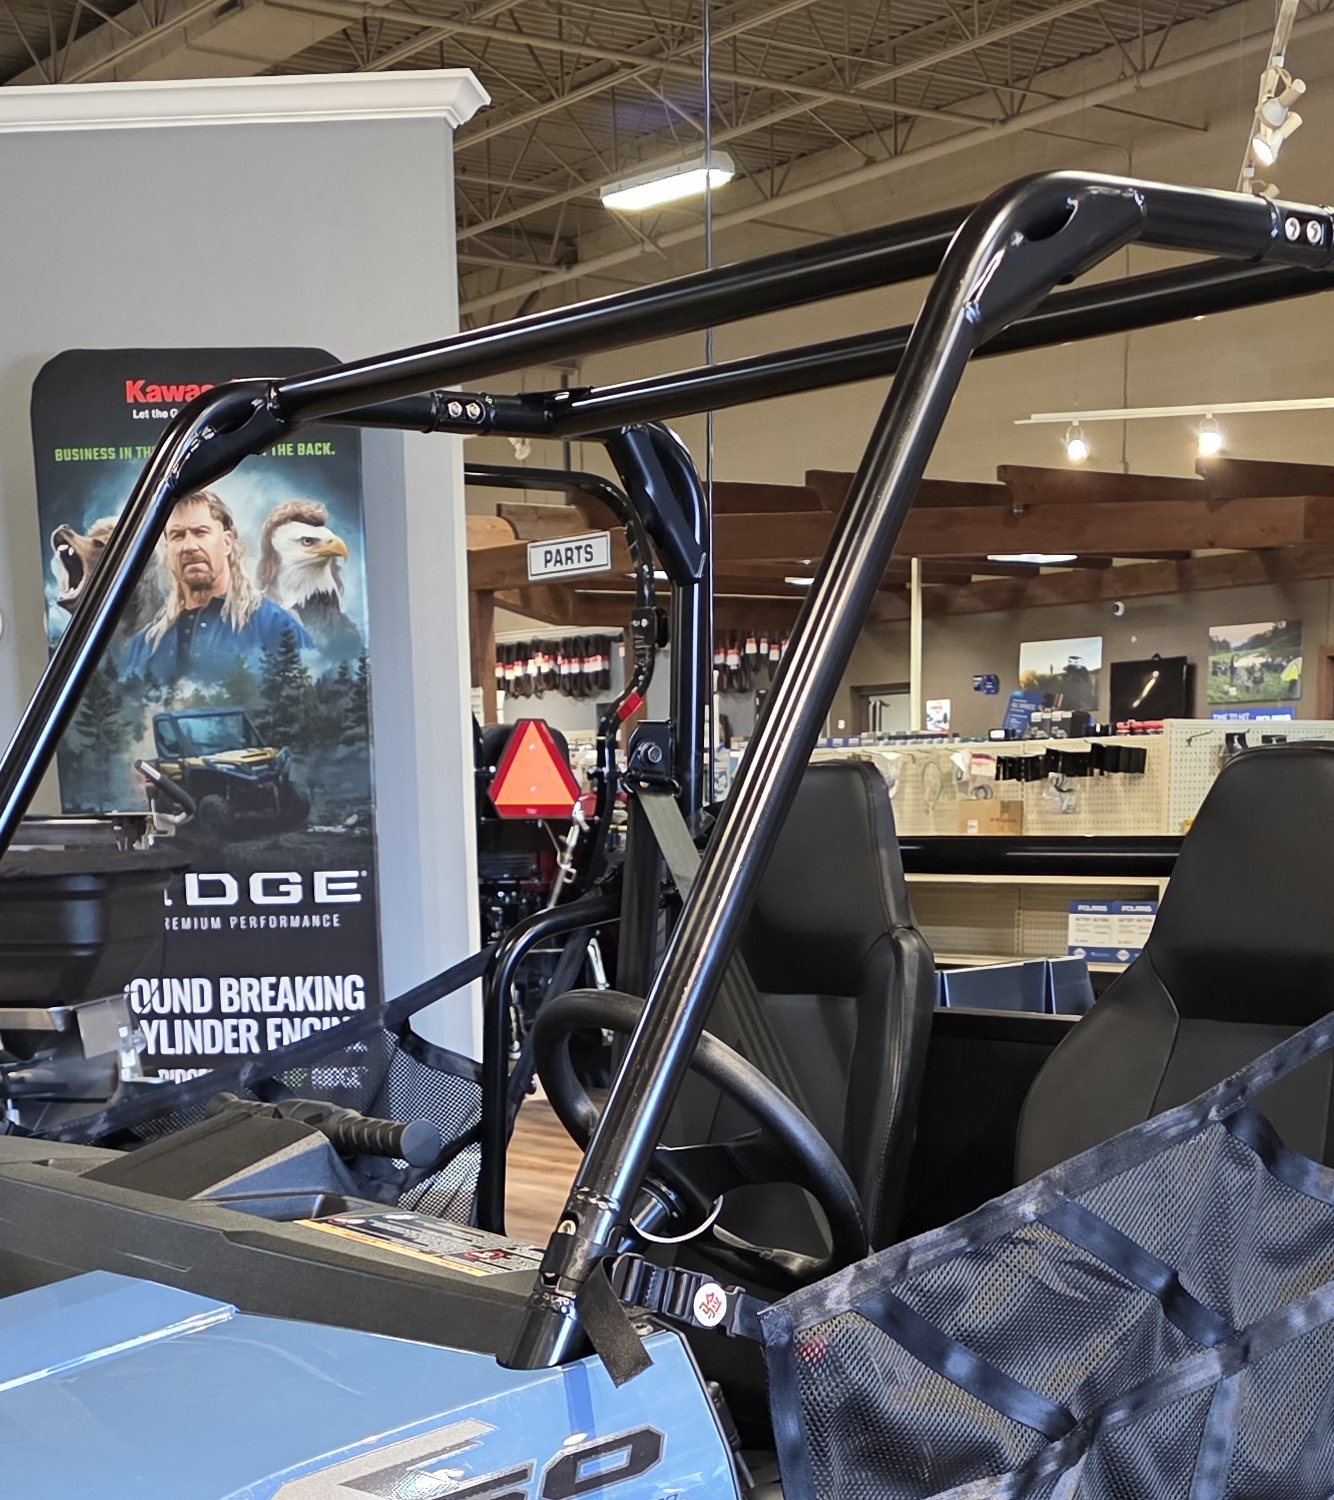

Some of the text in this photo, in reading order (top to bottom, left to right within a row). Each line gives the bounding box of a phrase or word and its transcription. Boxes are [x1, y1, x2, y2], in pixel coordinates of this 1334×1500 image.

[132, 409, 149, 419] Let
[151, 408, 169, 419] the
[55, 445, 155, 462] BUSINESS IN TH
[297, 442, 336, 456] BACK.
[544, 543, 593, 569] PARTS
[229, 913, 341, 930] PERFORMANCE
[124, 973, 366, 1015] OUND BREAKING
[698, 1291, 723, 1320] 验
